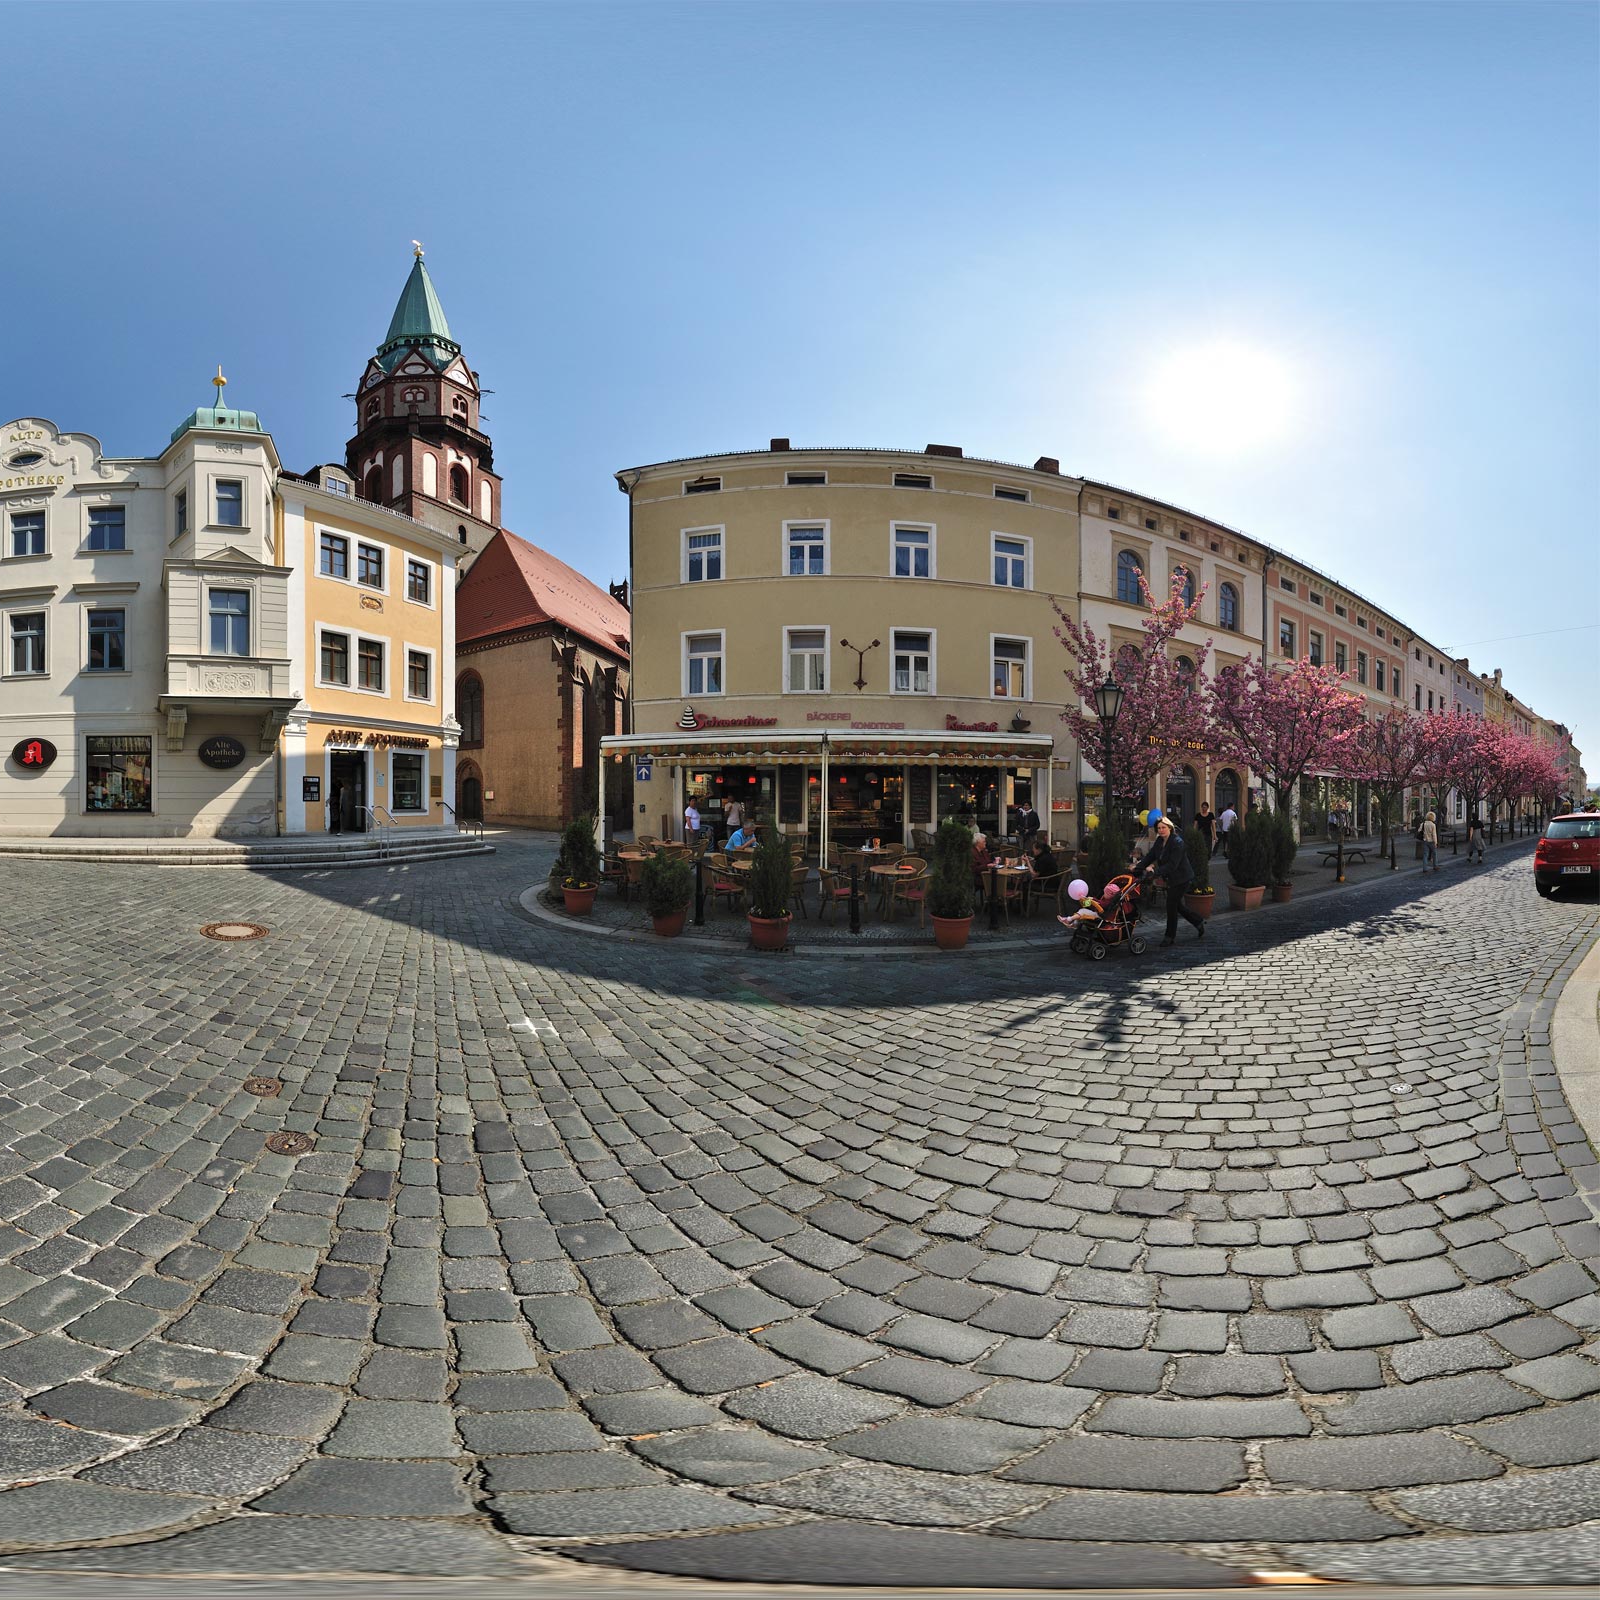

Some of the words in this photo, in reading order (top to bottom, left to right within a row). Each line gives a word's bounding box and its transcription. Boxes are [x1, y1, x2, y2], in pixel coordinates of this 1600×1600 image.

[9, 431, 43, 443] ALTE
[806, 711, 851, 721] BÄCKEREI
[850, 721, 905, 730] KONDITOREI
[328, 729, 363, 745] ALTE
[215, 741, 231, 749] Alte
[205, 748, 241, 758] Apotheke
